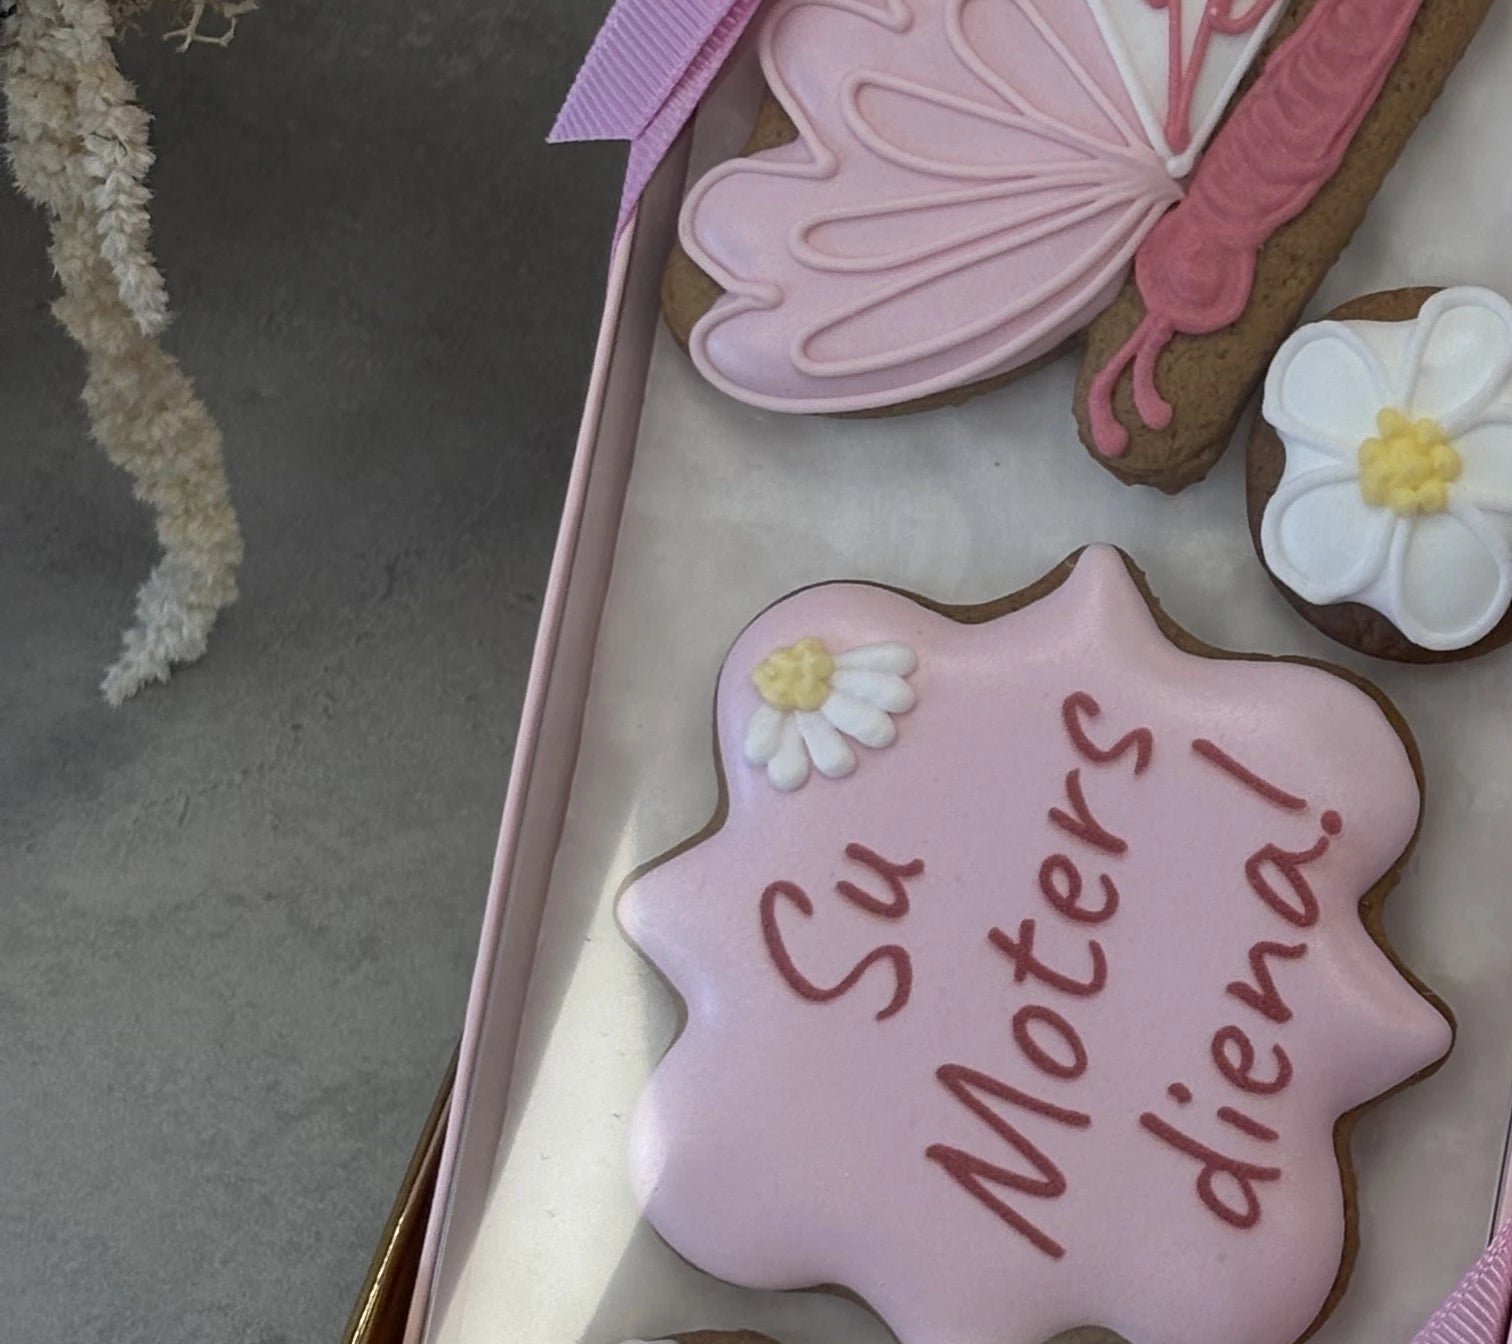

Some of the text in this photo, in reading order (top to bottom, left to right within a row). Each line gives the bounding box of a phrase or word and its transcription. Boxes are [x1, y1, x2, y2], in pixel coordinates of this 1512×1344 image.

[759, 843, 925, 1021] Su
[926, 691, 1153, 1258] Moters
[1140, 737, 1342, 1229] diena!
